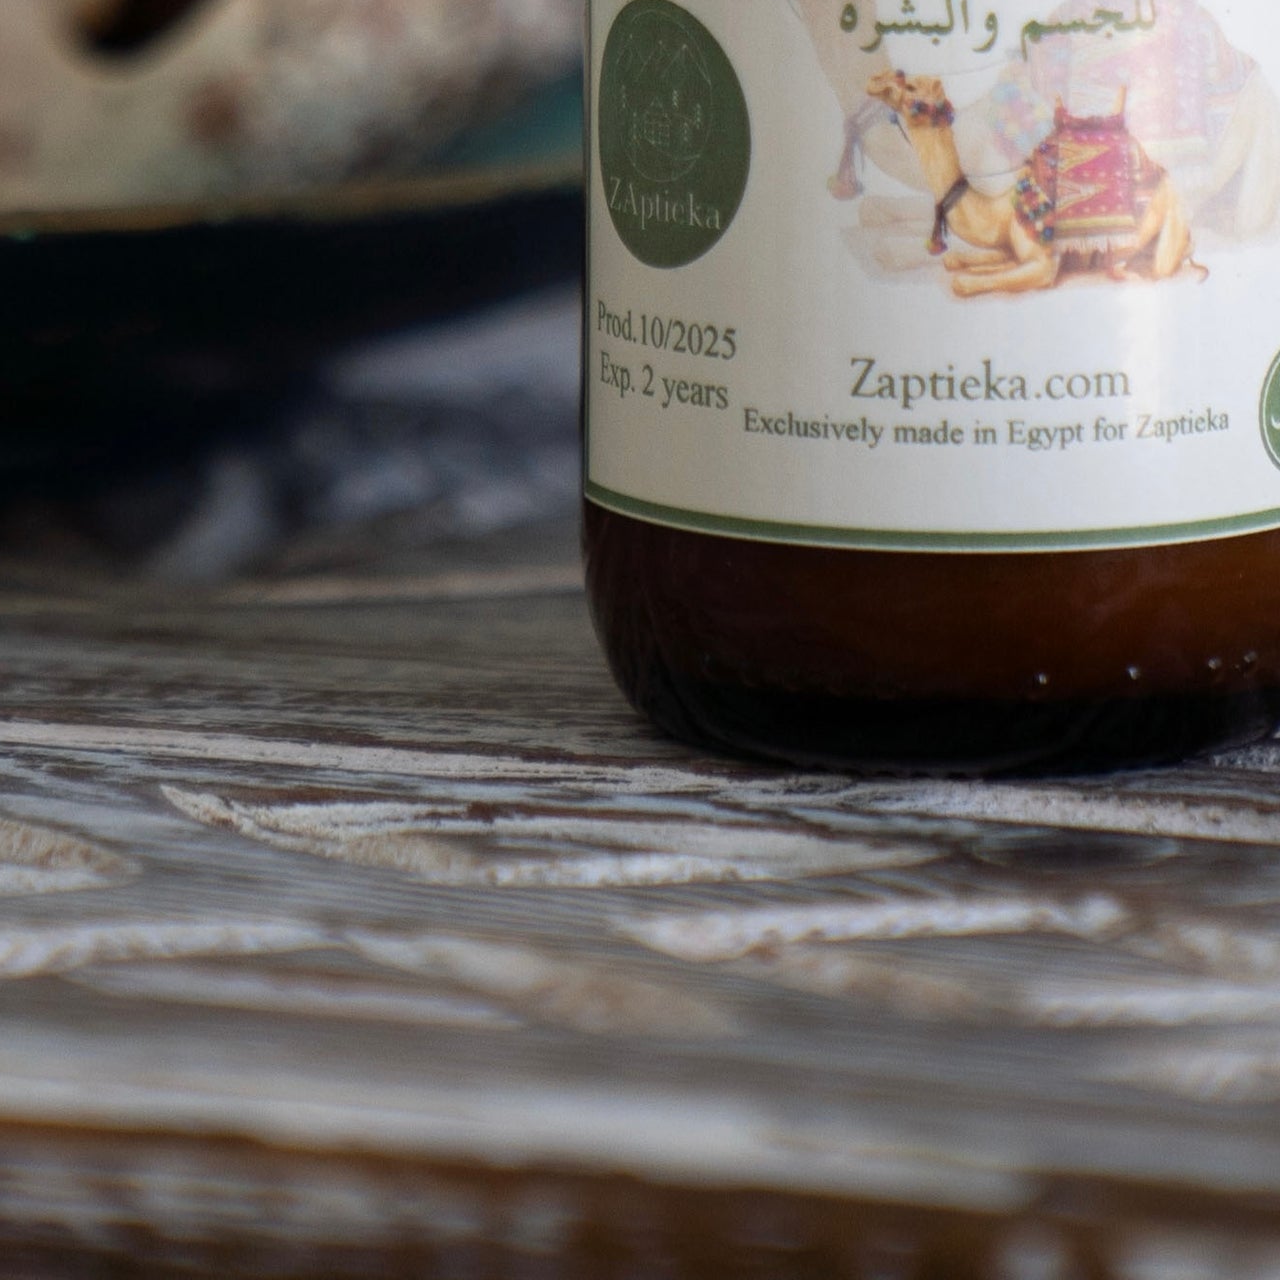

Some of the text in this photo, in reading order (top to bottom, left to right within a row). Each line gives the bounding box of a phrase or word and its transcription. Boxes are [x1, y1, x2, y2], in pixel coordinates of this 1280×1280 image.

[601, 351, 729, 410] Exp. 2 years
[850, 357, 1131, 410] Zaptieka.com
[743, 407, 1230, 451] Exclusively made in Egypt for Zaptieka
